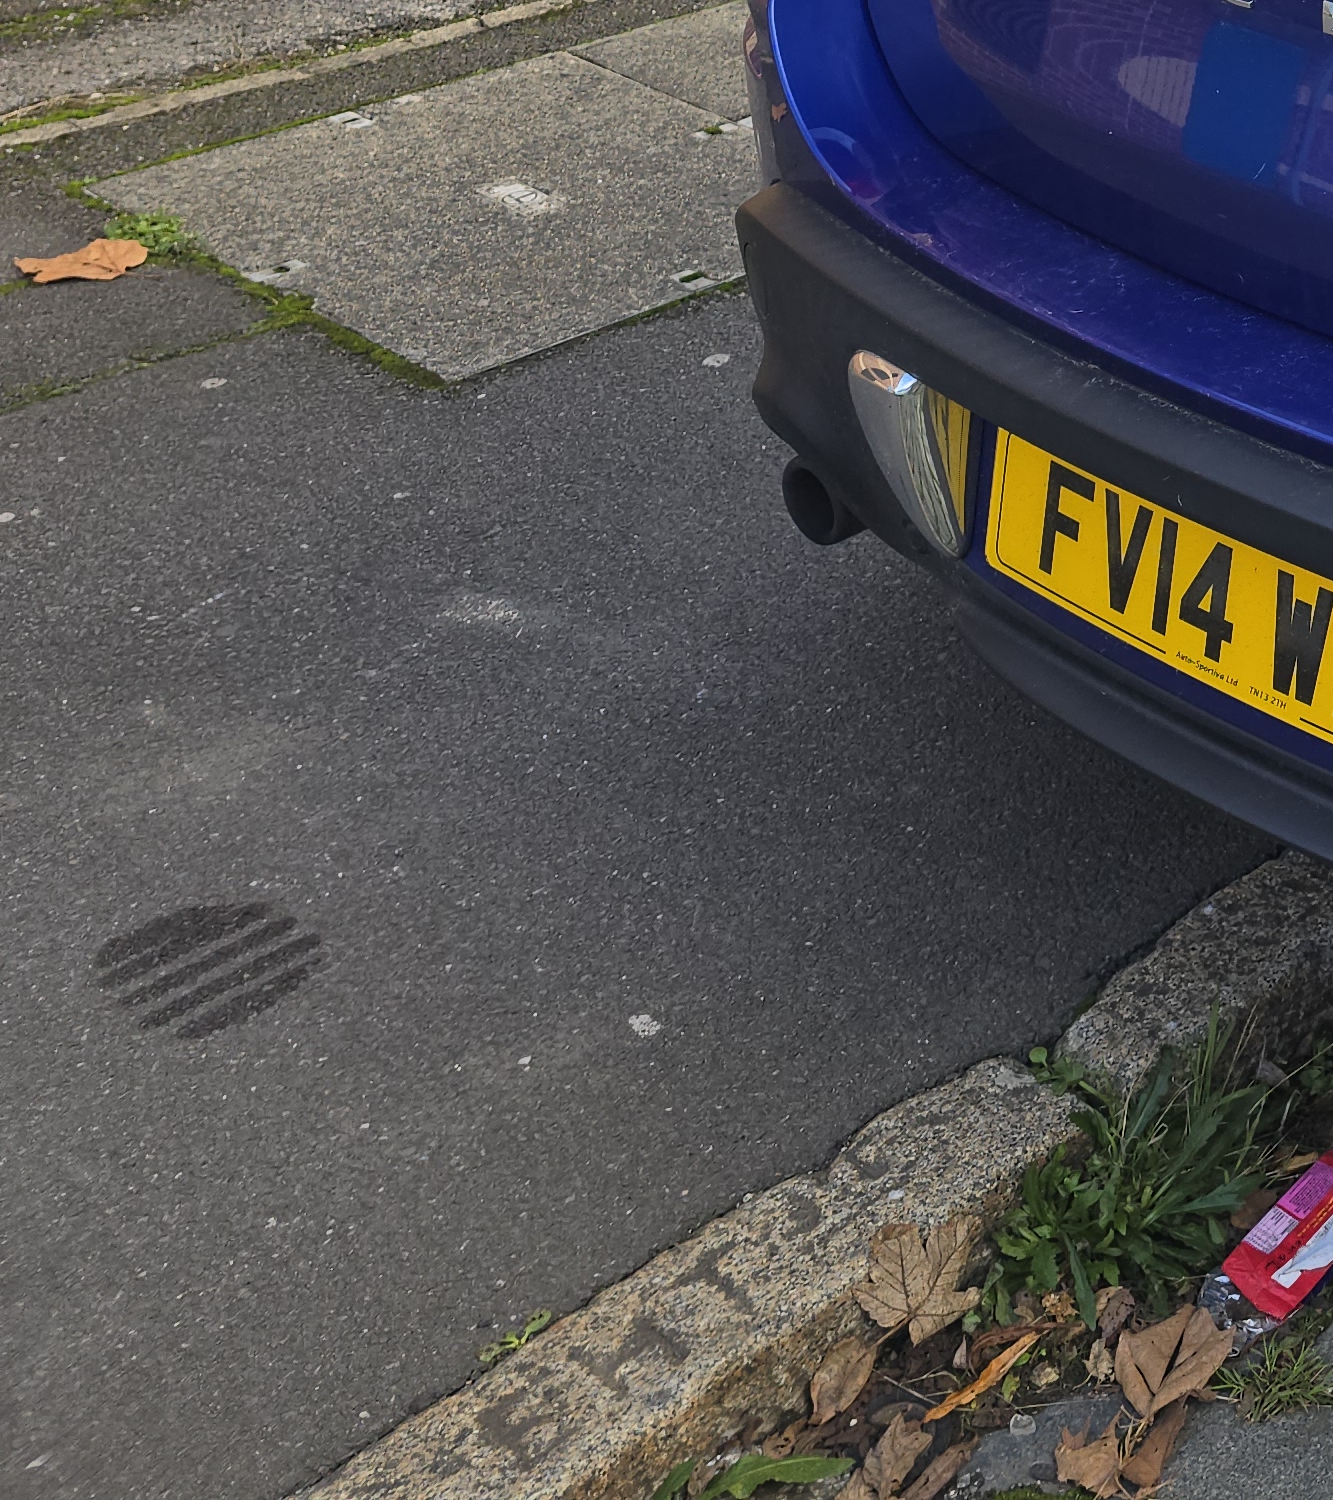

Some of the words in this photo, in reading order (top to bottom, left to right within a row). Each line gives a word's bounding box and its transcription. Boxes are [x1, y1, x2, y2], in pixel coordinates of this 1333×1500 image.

[1038, 460, 1234, 663] FV14
[1225, 674, 1239, 687] Ltd
[1249, 685, 1270, 702] TN13
